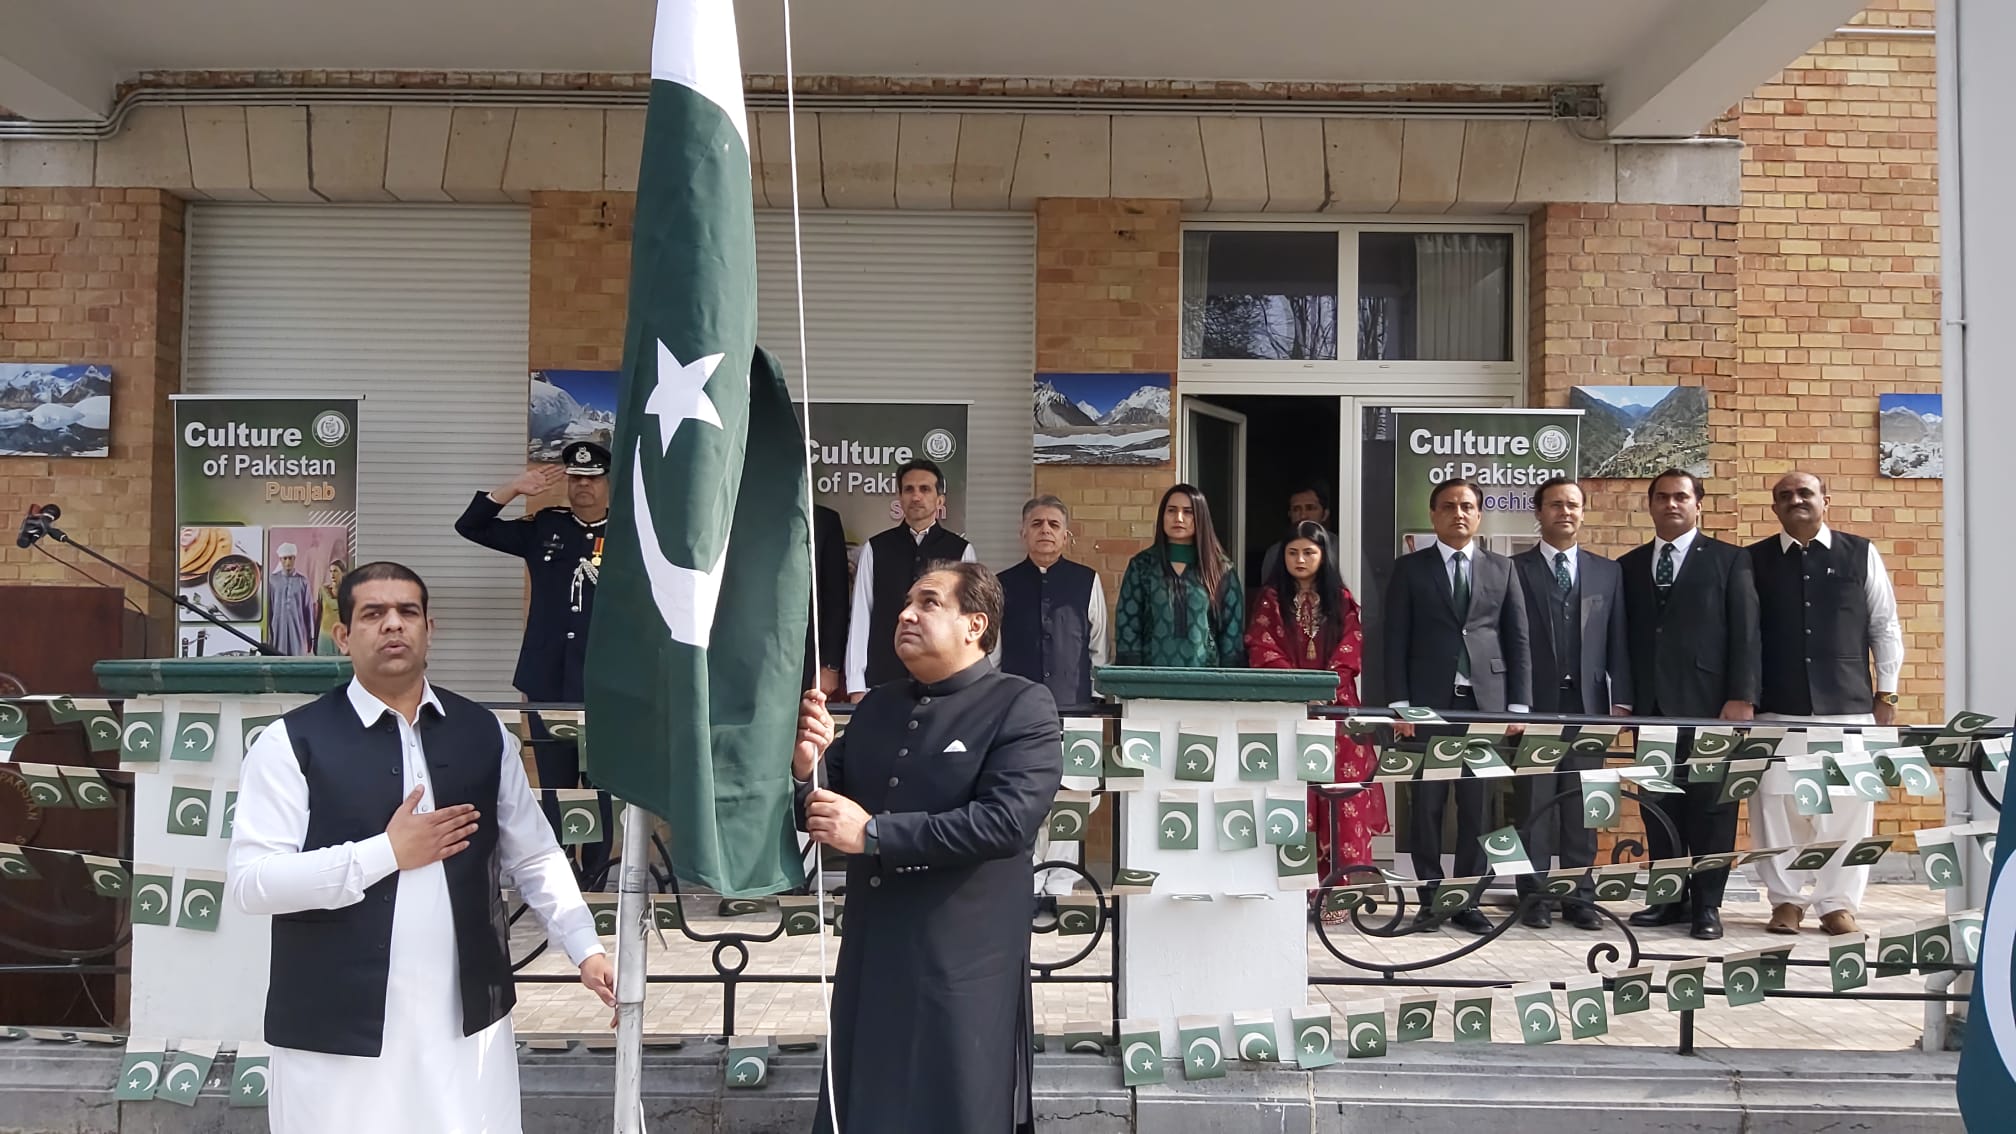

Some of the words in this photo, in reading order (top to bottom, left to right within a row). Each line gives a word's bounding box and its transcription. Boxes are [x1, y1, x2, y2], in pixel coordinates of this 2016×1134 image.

[184, 421, 303, 447] Culture
[1409, 428, 1530, 455] Culture
[203, 454, 229, 476] of
[234, 454, 336, 476] Pakistan
[1429, 462, 1455, 484] of
[1461, 462, 1565, 485] Pakistan
[265, 481, 336, 506] Punjab
[817, 471, 842, 493] of
